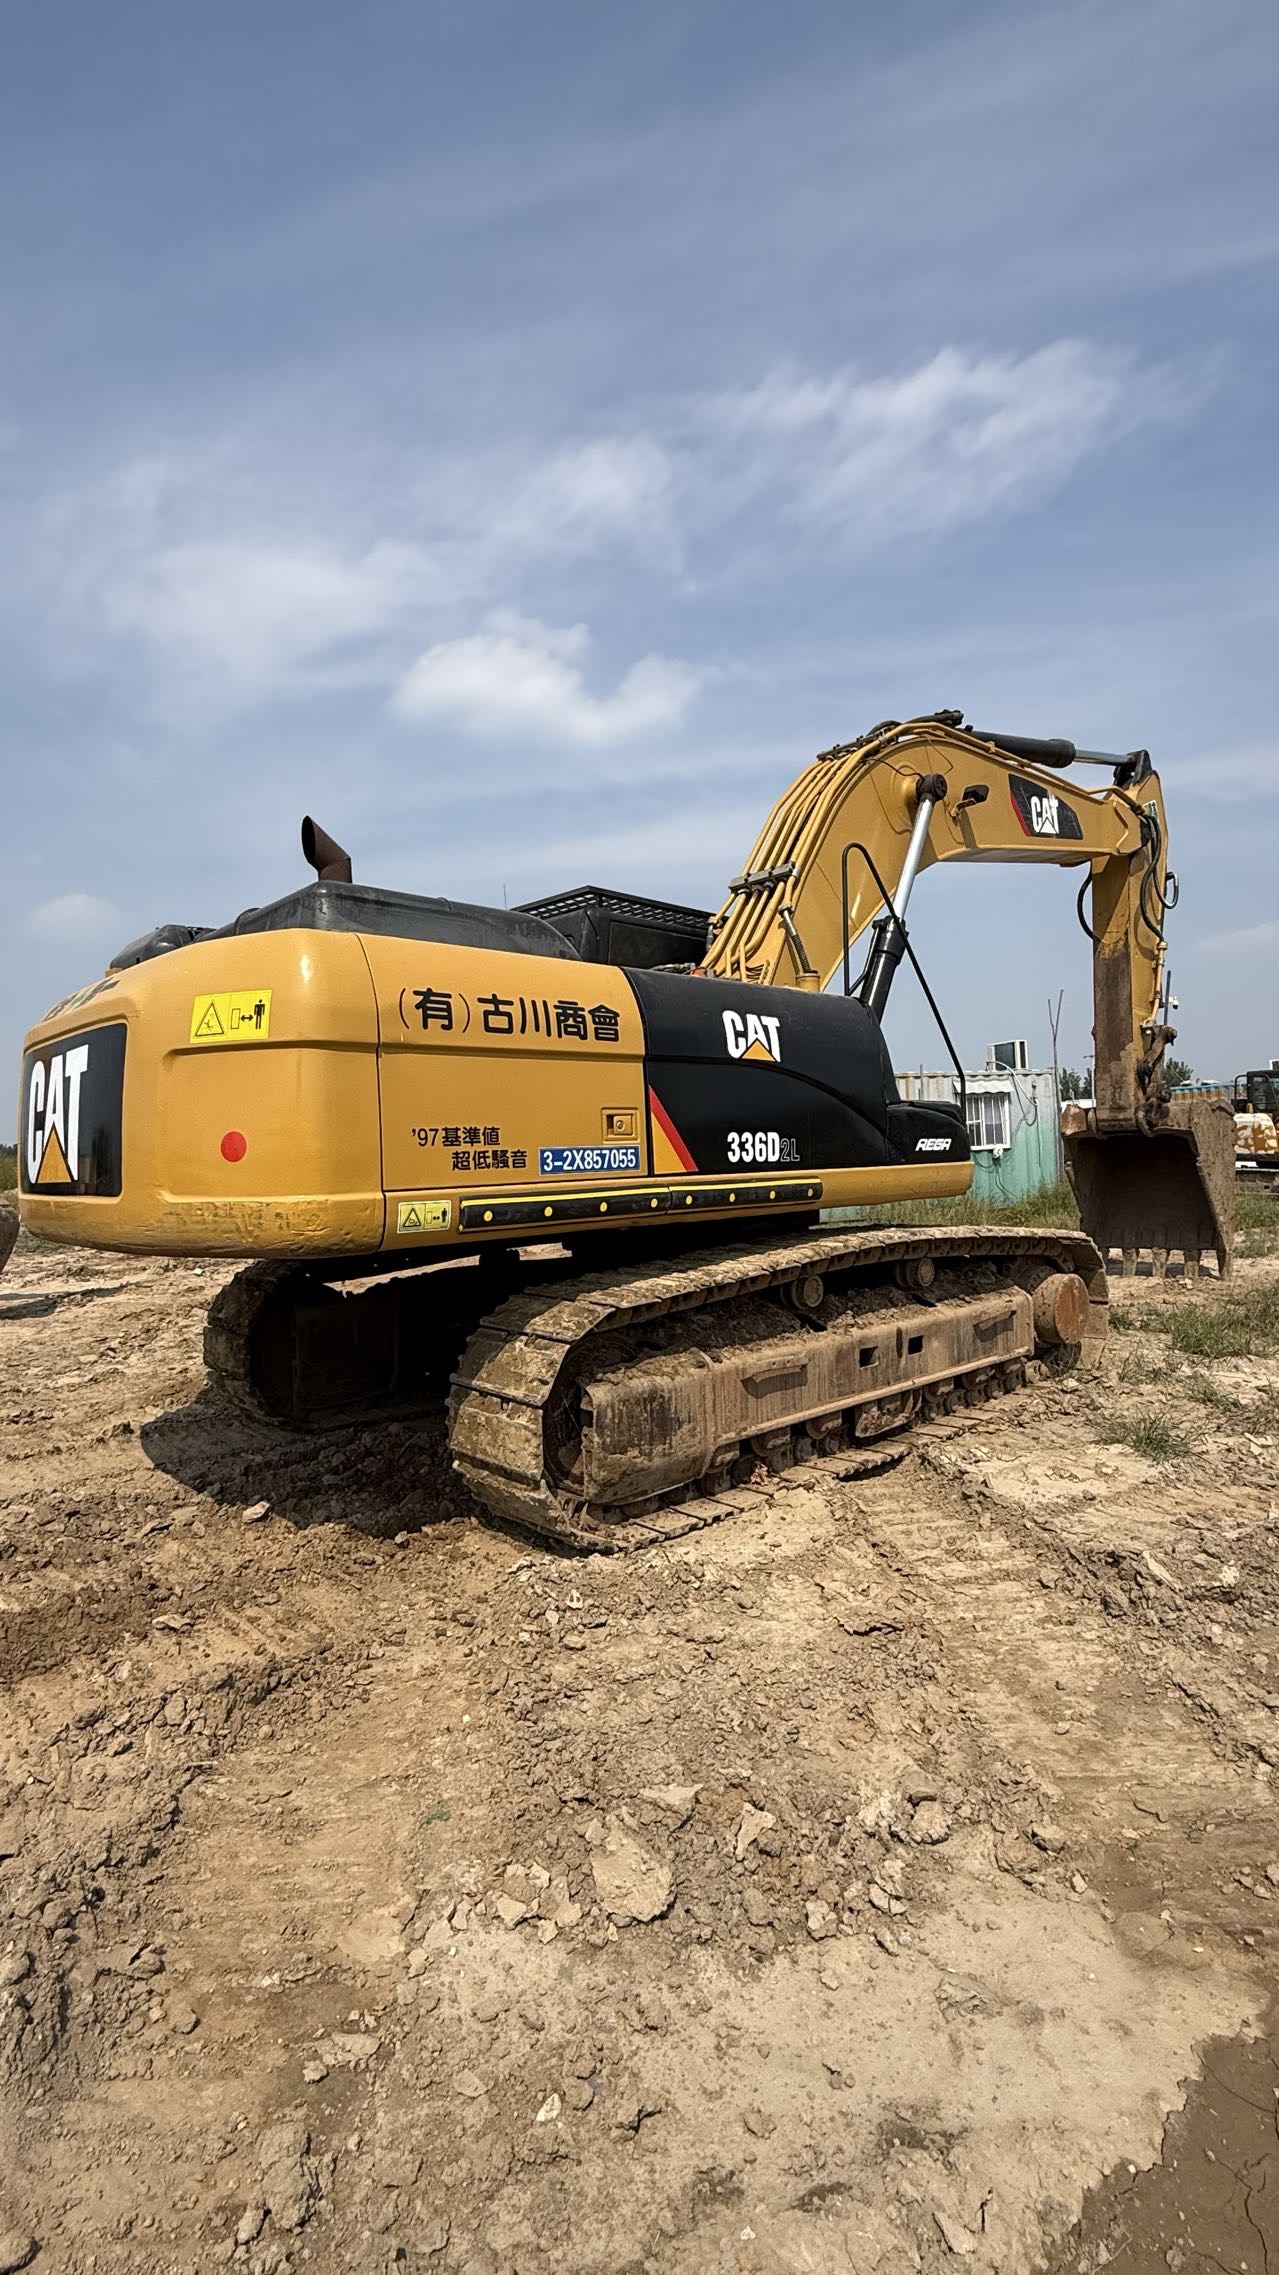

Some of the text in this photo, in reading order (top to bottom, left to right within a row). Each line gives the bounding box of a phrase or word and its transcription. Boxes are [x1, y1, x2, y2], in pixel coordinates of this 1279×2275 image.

[1030, 795, 1060, 835] CAT
[722, 1010, 781, 1063] CAT
[27, 1044, 89, 1185] CAT
[543, 1149, 636, 1171] 3-2X857055
